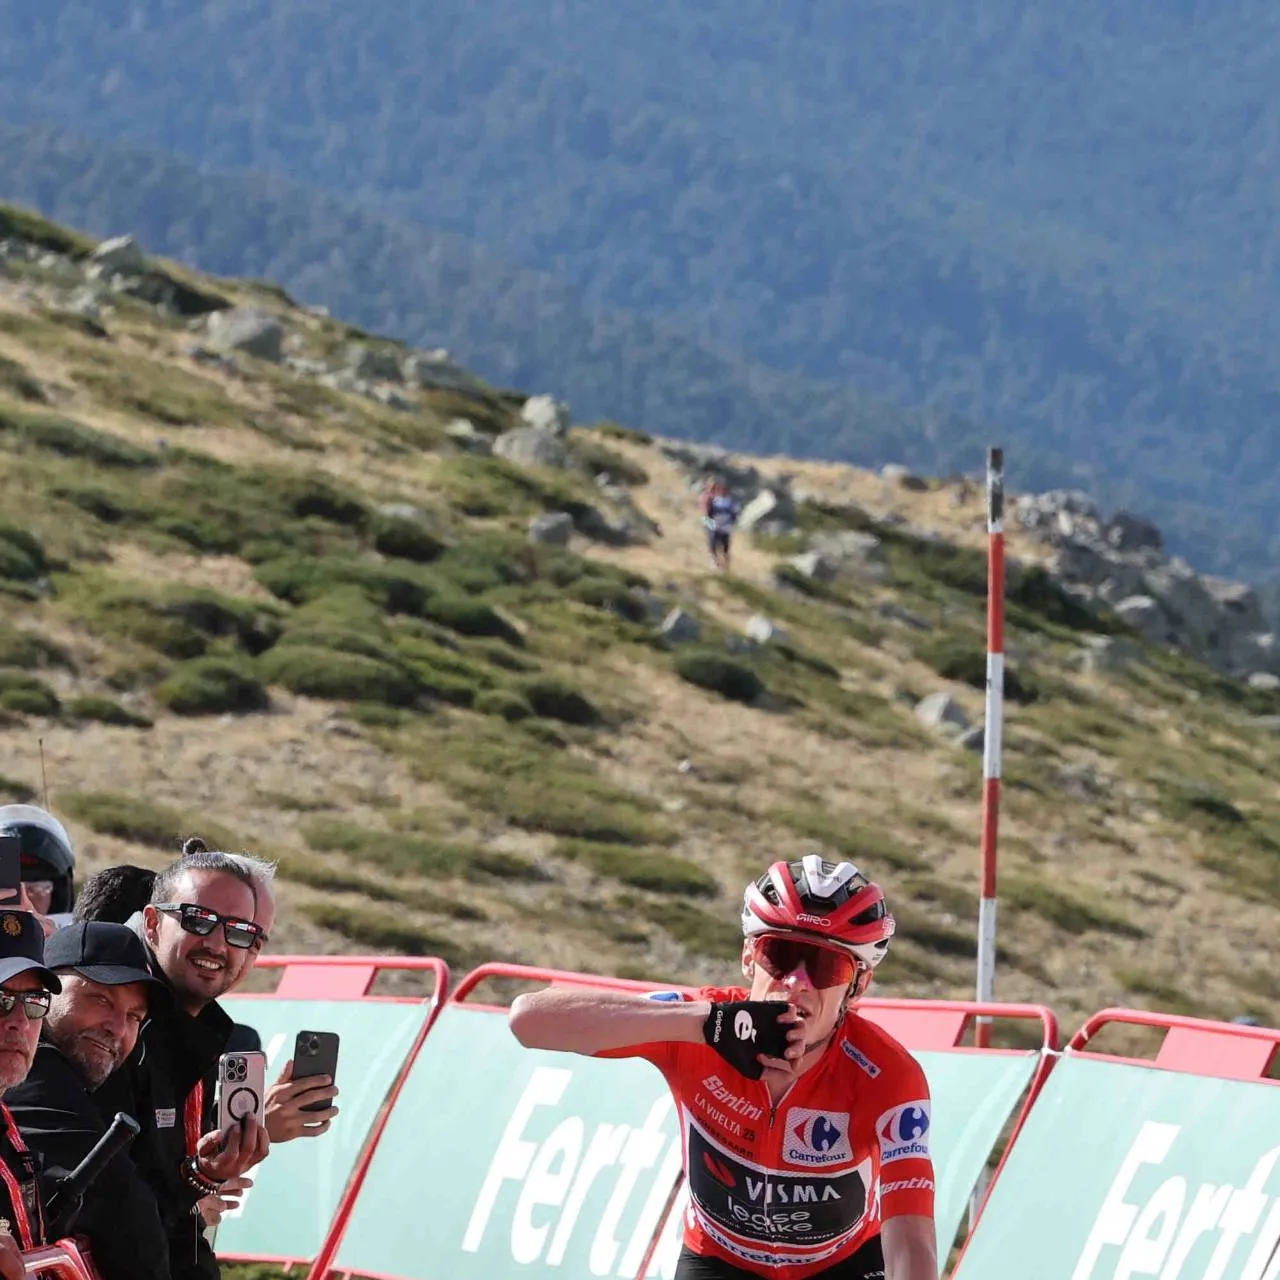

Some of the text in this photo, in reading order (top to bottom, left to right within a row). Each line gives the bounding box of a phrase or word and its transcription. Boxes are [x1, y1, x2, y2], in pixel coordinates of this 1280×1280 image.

[796, 913, 832, 927] GIRO
[702, 1074, 763, 1121] Santini
[694, 1092, 706, 1109] LA
[706, 1103, 741, 1137] VUELTA
[789, 1149, 847, 1163] Carrefour
[881, 1142, 929, 1161] Carrefou
[745, 1175, 841, 1204] VISMA
[880, 1176, 935, 1195] antin
[727, 1195, 811, 1227] lease
